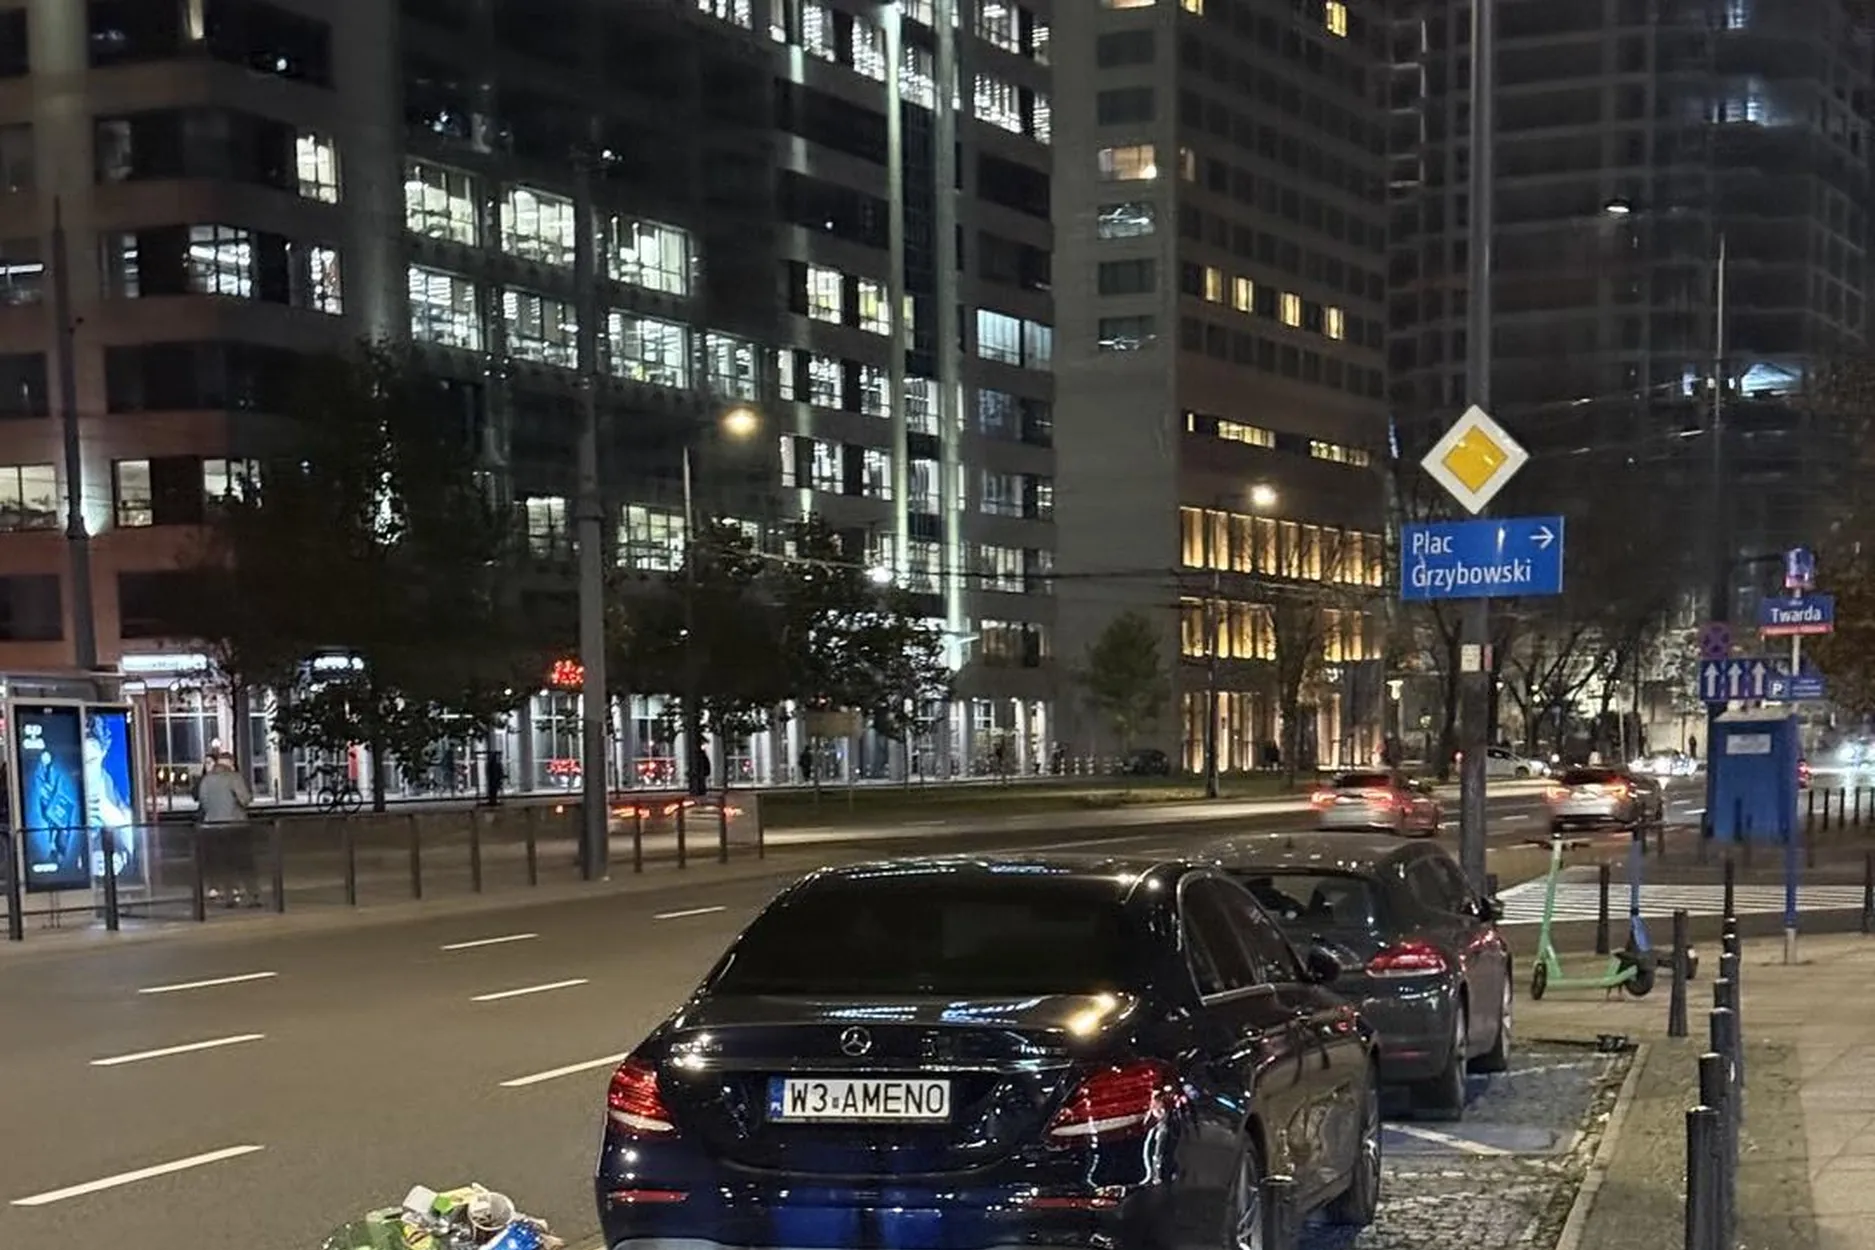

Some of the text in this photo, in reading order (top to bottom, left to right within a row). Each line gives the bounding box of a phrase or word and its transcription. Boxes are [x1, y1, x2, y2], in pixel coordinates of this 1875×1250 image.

[1412, 530, 1454, 555] Plac
[1411, 558, 1533, 592] Grzybowski
[1769, 604, 1822, 624] Twarda
[790, 1082, 829, 1113] W3
[841, 1082, 945, 1114] AMENO
